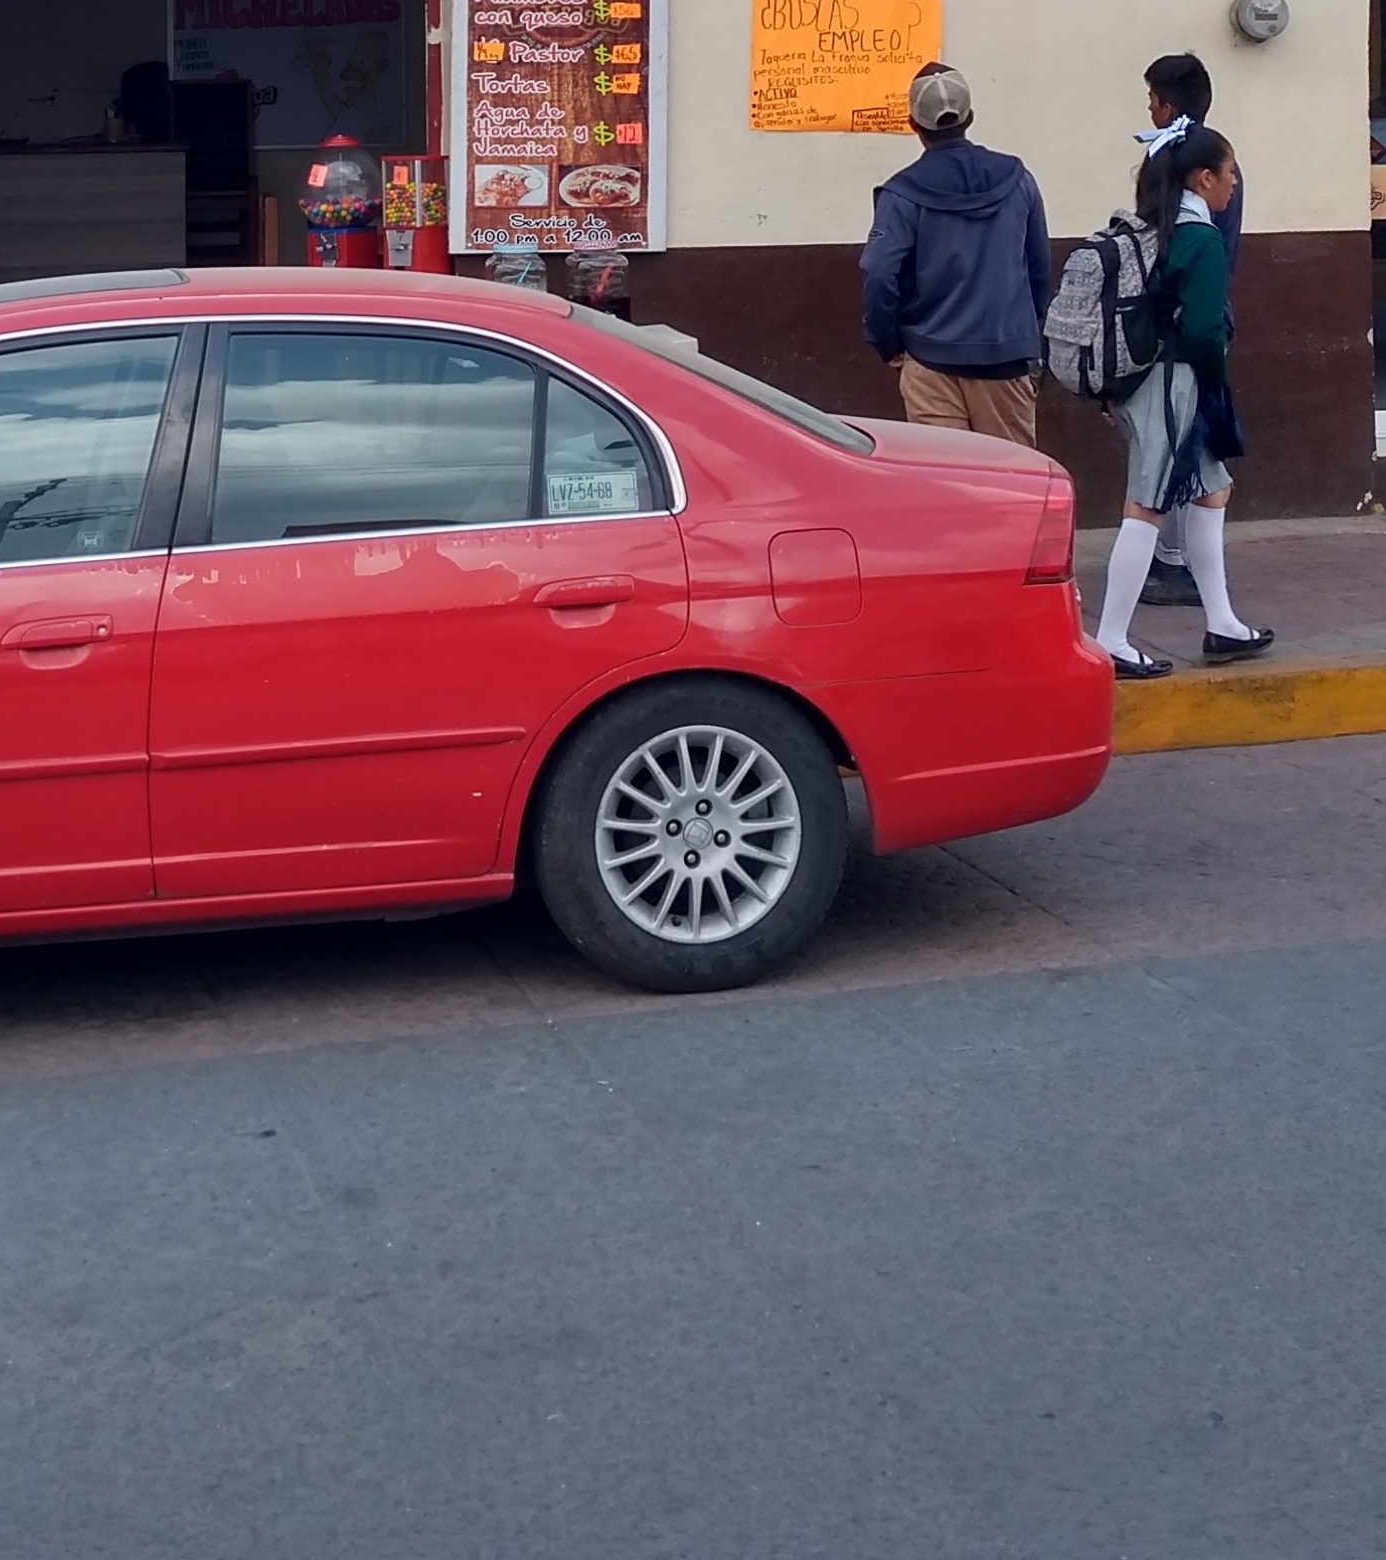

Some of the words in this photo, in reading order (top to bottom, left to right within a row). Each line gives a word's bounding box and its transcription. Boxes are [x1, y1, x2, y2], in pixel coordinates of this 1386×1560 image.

[474, 11, 512, 25] con
[520, 12, 584, 31] queso
[509, 41, 585, 63] Pastor
[811, 50, 826, 64] La
[832, 51, 871, 68] Fragua
[471, 71, 551, 95] Tortas
[474, 100, 530, 125] Agua
[536, 102, 564, 119] de
[474, 117, 567, 139] Horchata
[573, 125, 589, 144] y
[473, 136, 558, 157] Jamaica
[510, 214, 576, 229] Servicio
[583, 214, 606, 228] de
[471, 228, 509, 243] 1:00
[515, 233, 537, 244] pm
[544, 233, 556, 244] a
[619, 231, 643, 243] am
